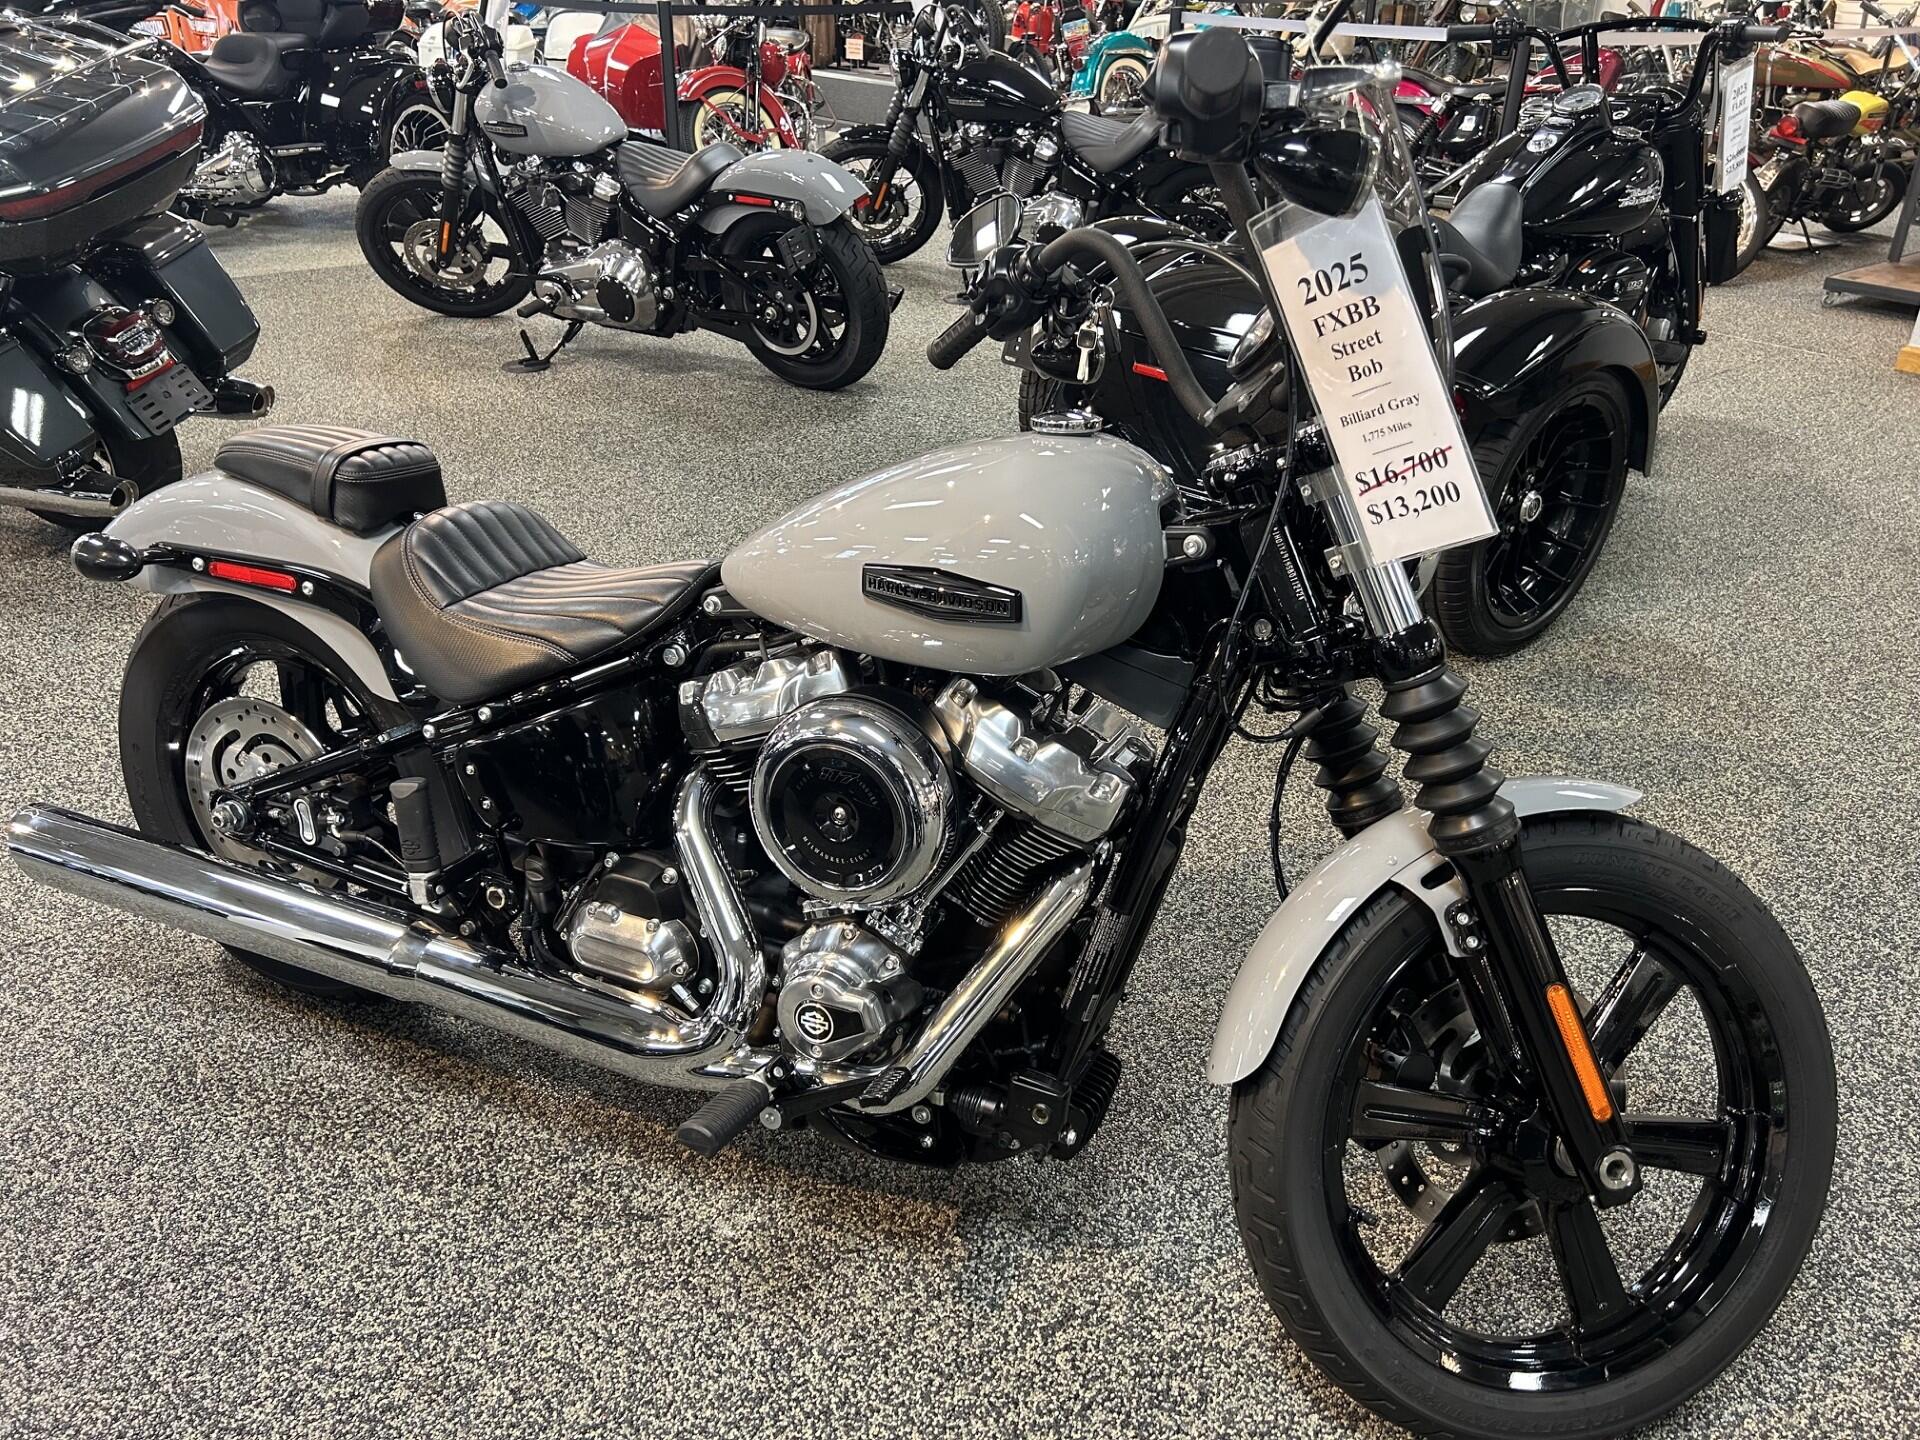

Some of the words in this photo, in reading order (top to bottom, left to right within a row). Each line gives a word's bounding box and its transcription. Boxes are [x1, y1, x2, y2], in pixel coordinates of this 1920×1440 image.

[1297, 252, 1369, 306] 2025
[1311, 295, 1381, 339] FXBB
[1330, 329, 1383, 361] Street
[1348, 358, 1383, 383] Bob
[1339, 404, 1386, 428] Billiard
[1387, 392, 1421, 415] Gray
[1362, 427, 1386, 444] 1,775
[1387, 420, 1413, 436] Miles
[1355, 446, 1449, 494] $16,700
[1367, 481, 1461, 526] $13,200
[867, 576, 1010, 616] HARLEY-DAVIDSON
[1574, 851, 1671, 880] DUNLOP
